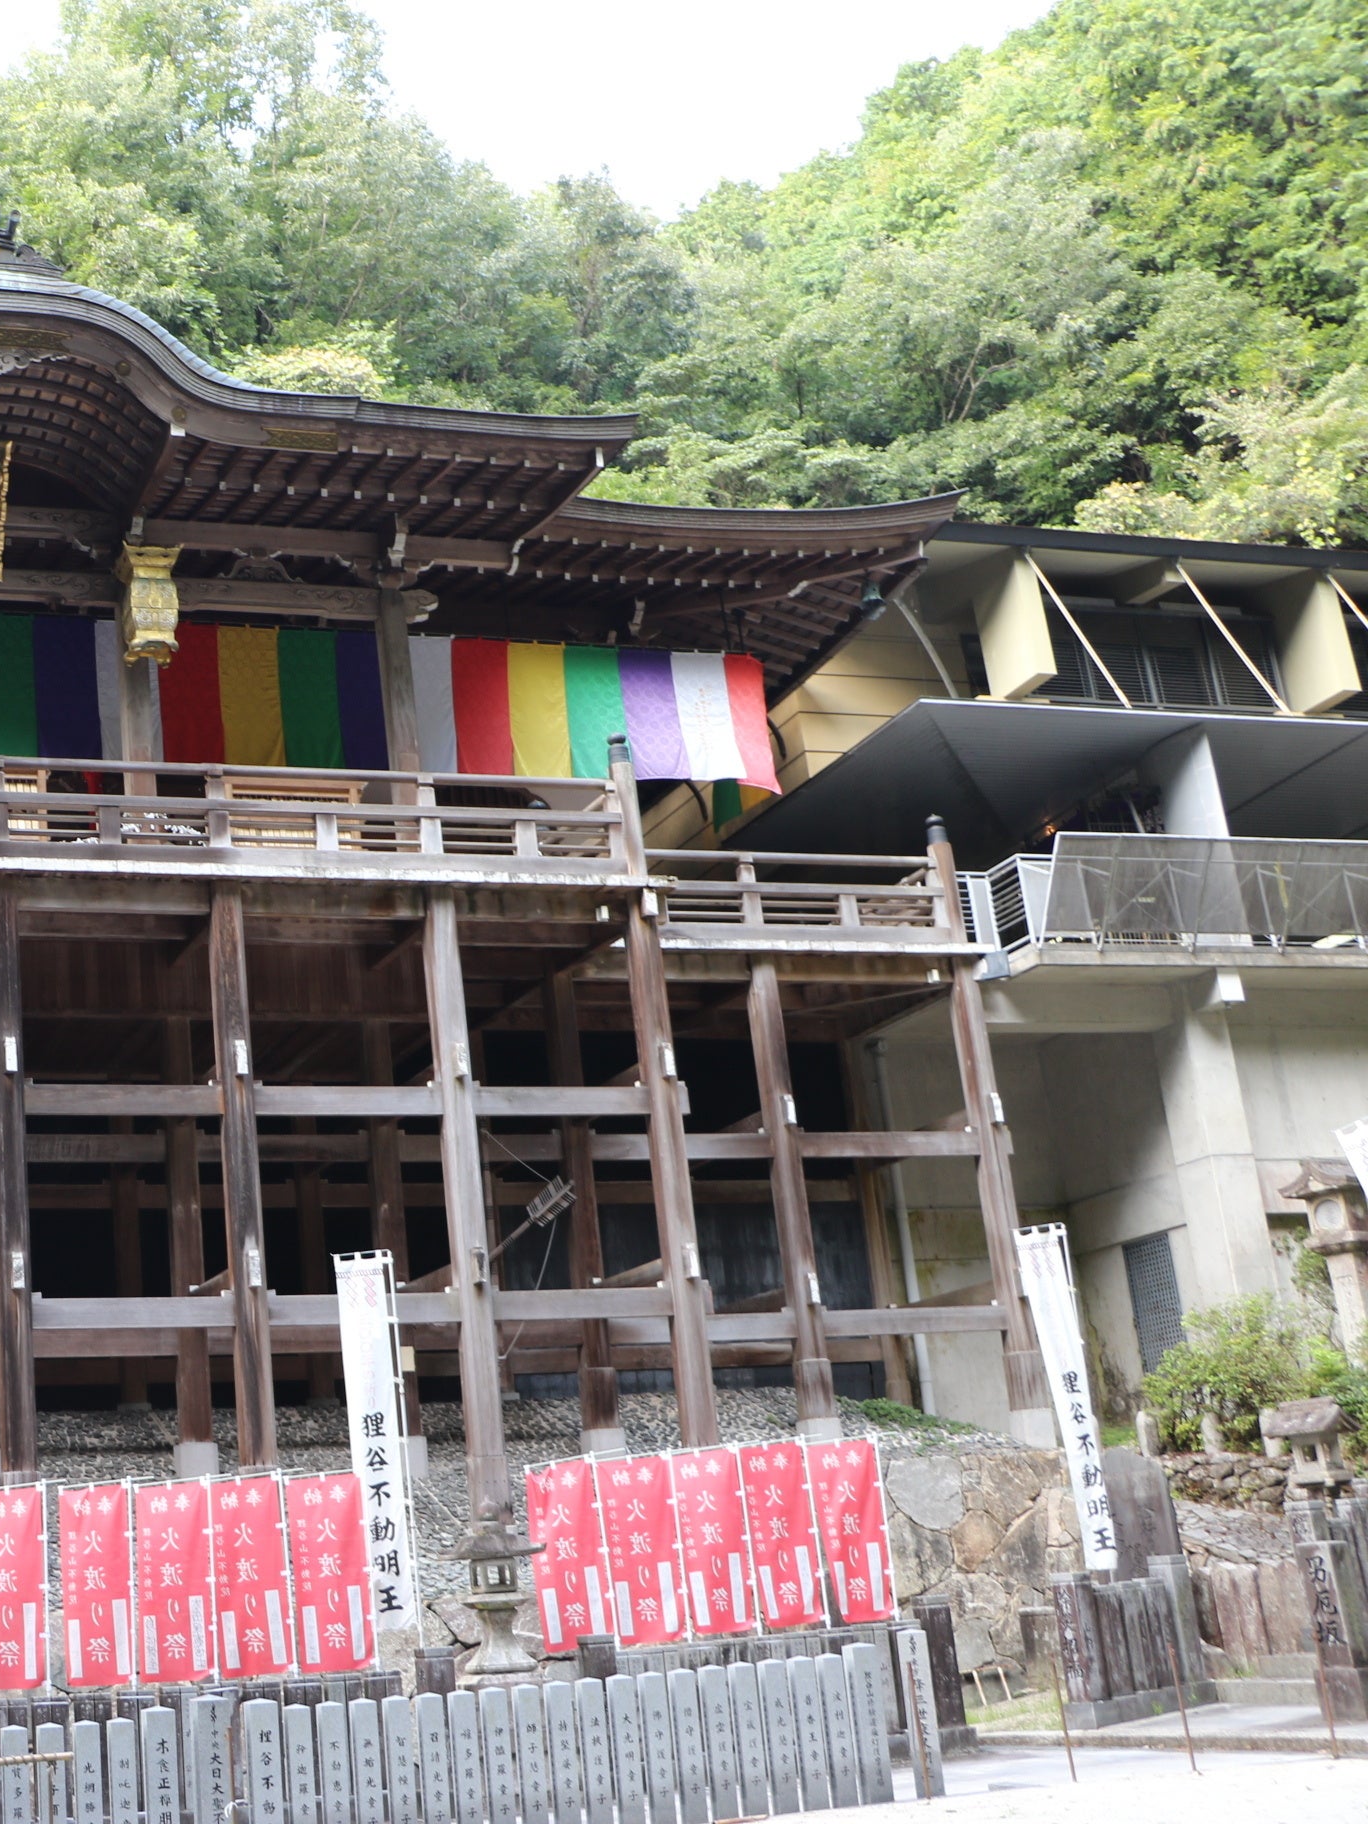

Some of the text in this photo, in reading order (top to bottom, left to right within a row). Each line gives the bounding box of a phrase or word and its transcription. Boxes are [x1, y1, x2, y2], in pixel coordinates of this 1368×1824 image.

[362, 1412, 403, 1613] 狸谷不動明王
[1062, 1371, 1117, 1553] 狸谷不動明王
